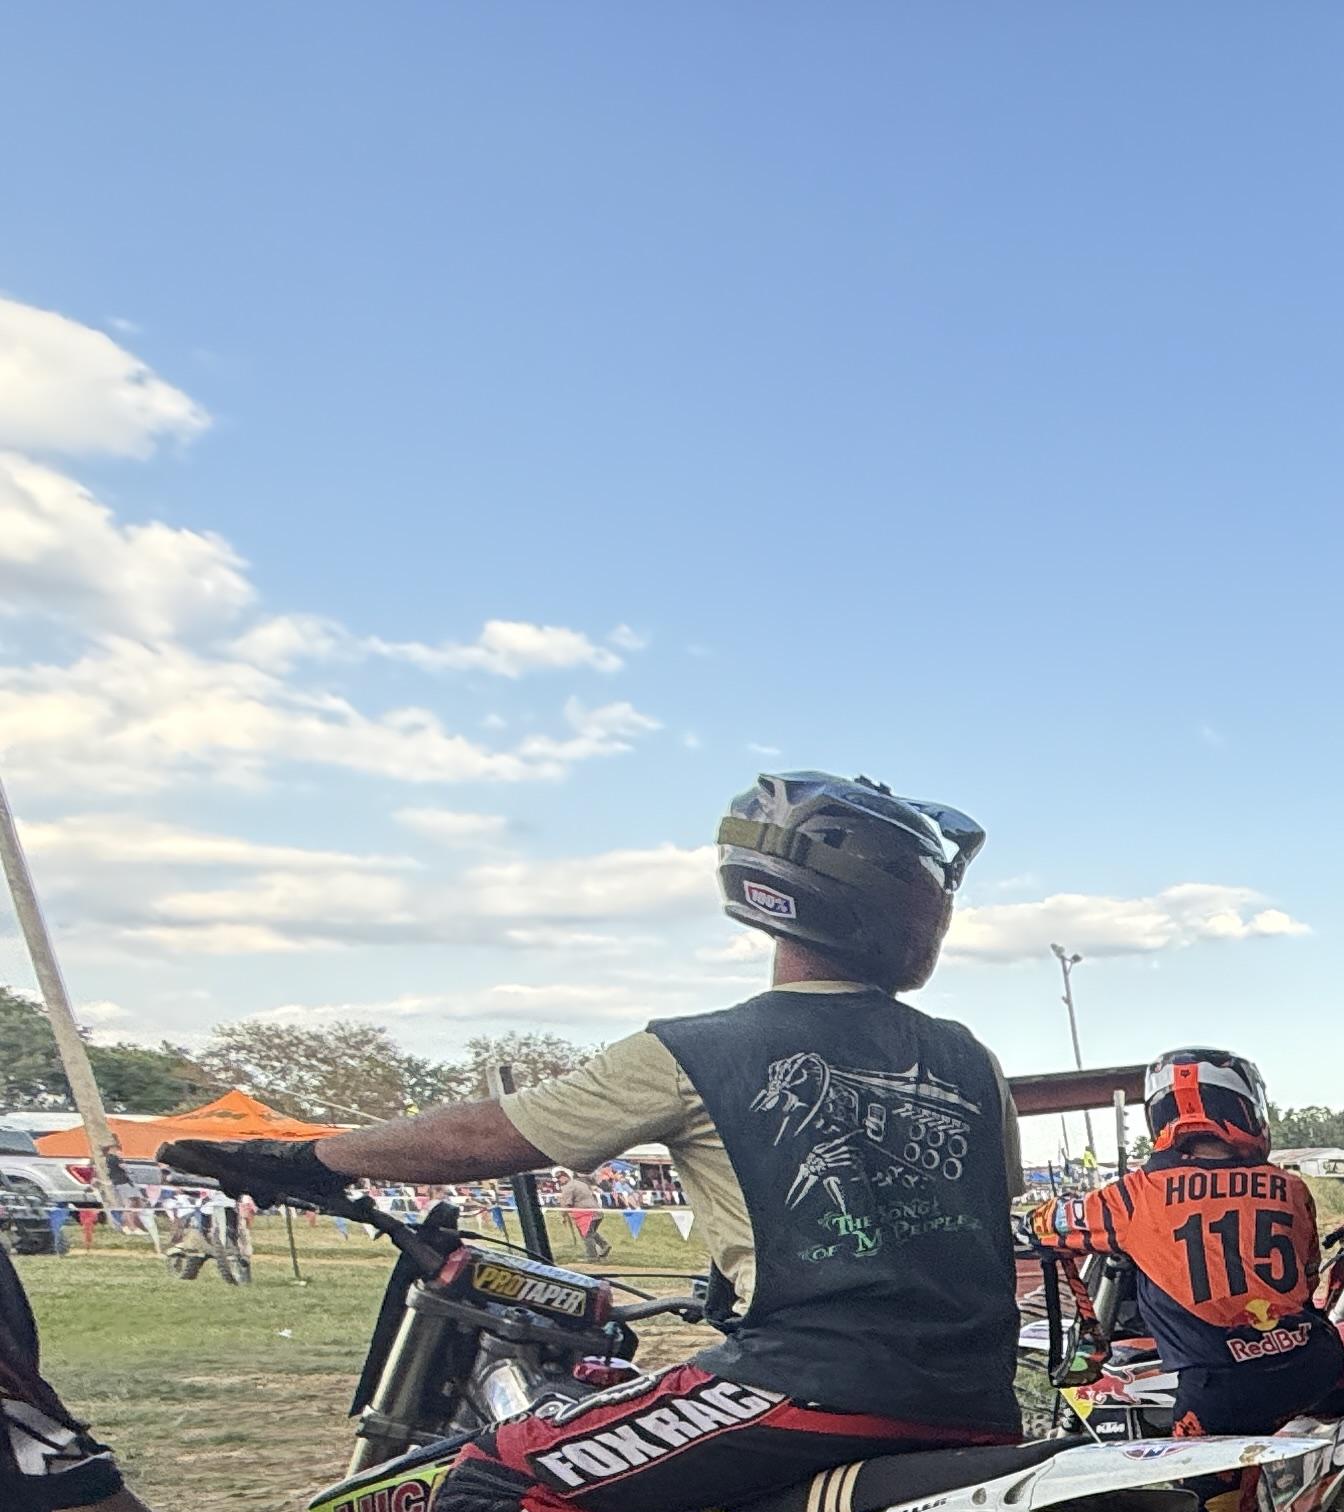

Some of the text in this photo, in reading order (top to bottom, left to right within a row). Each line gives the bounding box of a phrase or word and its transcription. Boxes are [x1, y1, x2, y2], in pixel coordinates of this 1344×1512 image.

[1165, 1171, 1288, 1206] HOLDER
[1173, 1208, 1299, 1305] 115
[1096, 1421, 1126, 1434] KTM
